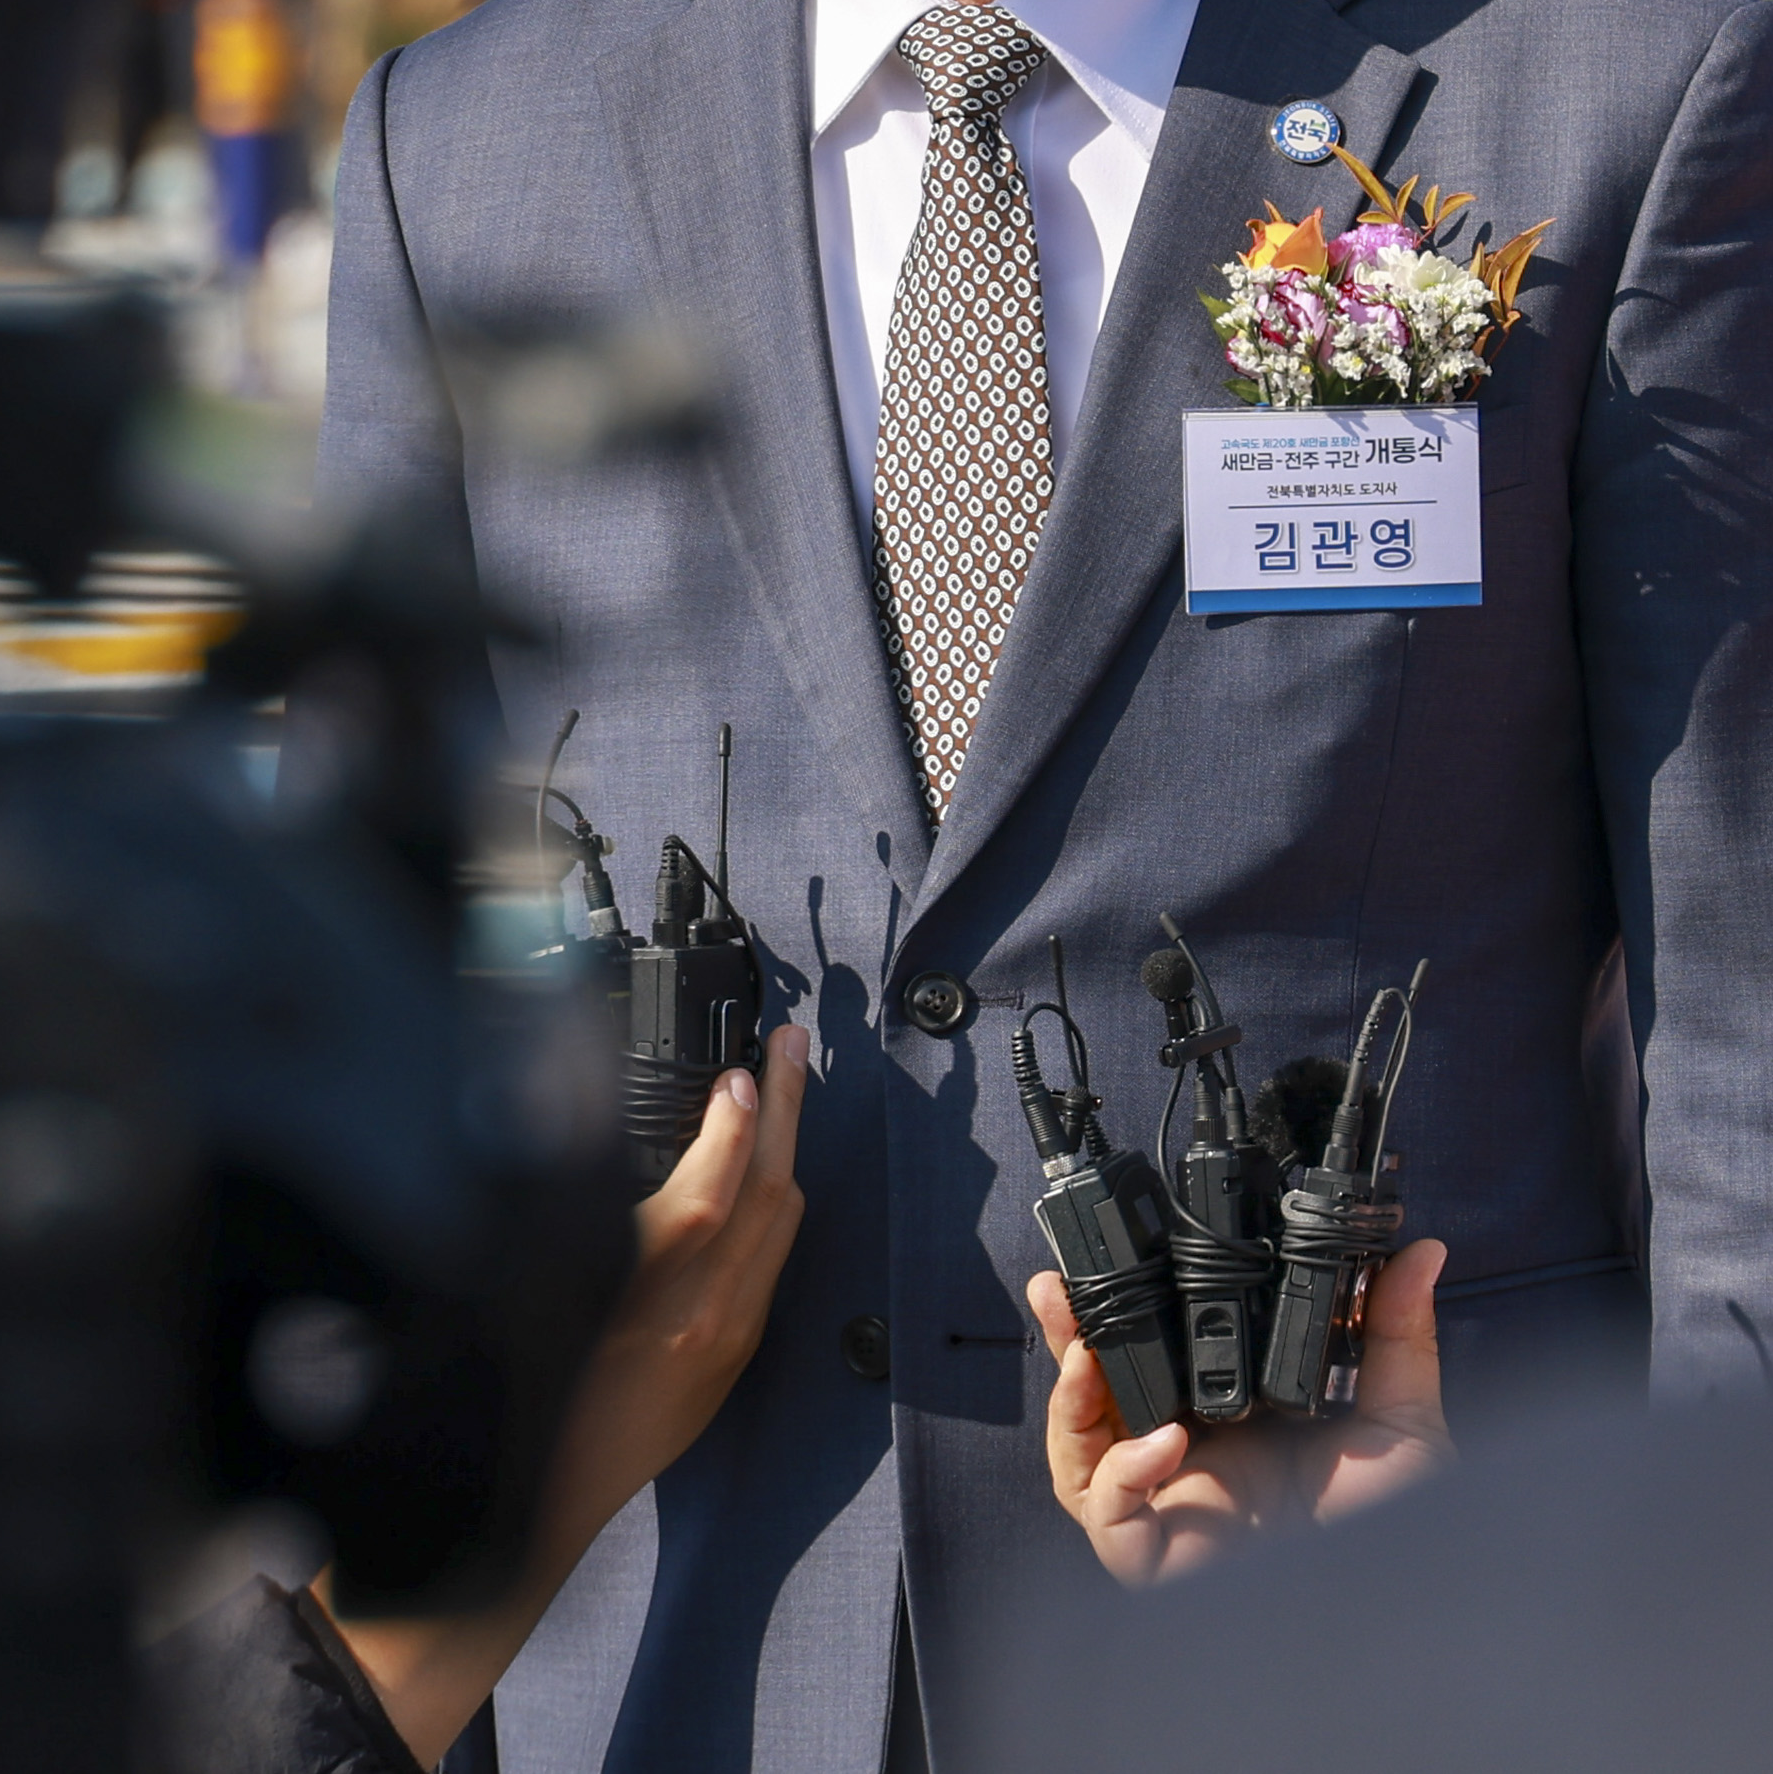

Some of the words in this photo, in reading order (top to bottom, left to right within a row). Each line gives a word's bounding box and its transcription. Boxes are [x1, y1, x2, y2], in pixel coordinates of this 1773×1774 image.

[1286, 119, 1327, 142] 전북
[1221, 438, 1260, 449] 고속국도
[1262, 438, 1297, 448] 제20호
[1221, 451, 1320, 471] 새만금-전주
[1324, 450, 1360, 469] 구간
[1365, 435, 1443, 464] 개통식
[1266, 484, 1356, 499] 전북특별자치도
[1359, 481, 1398, 496] 도지사
